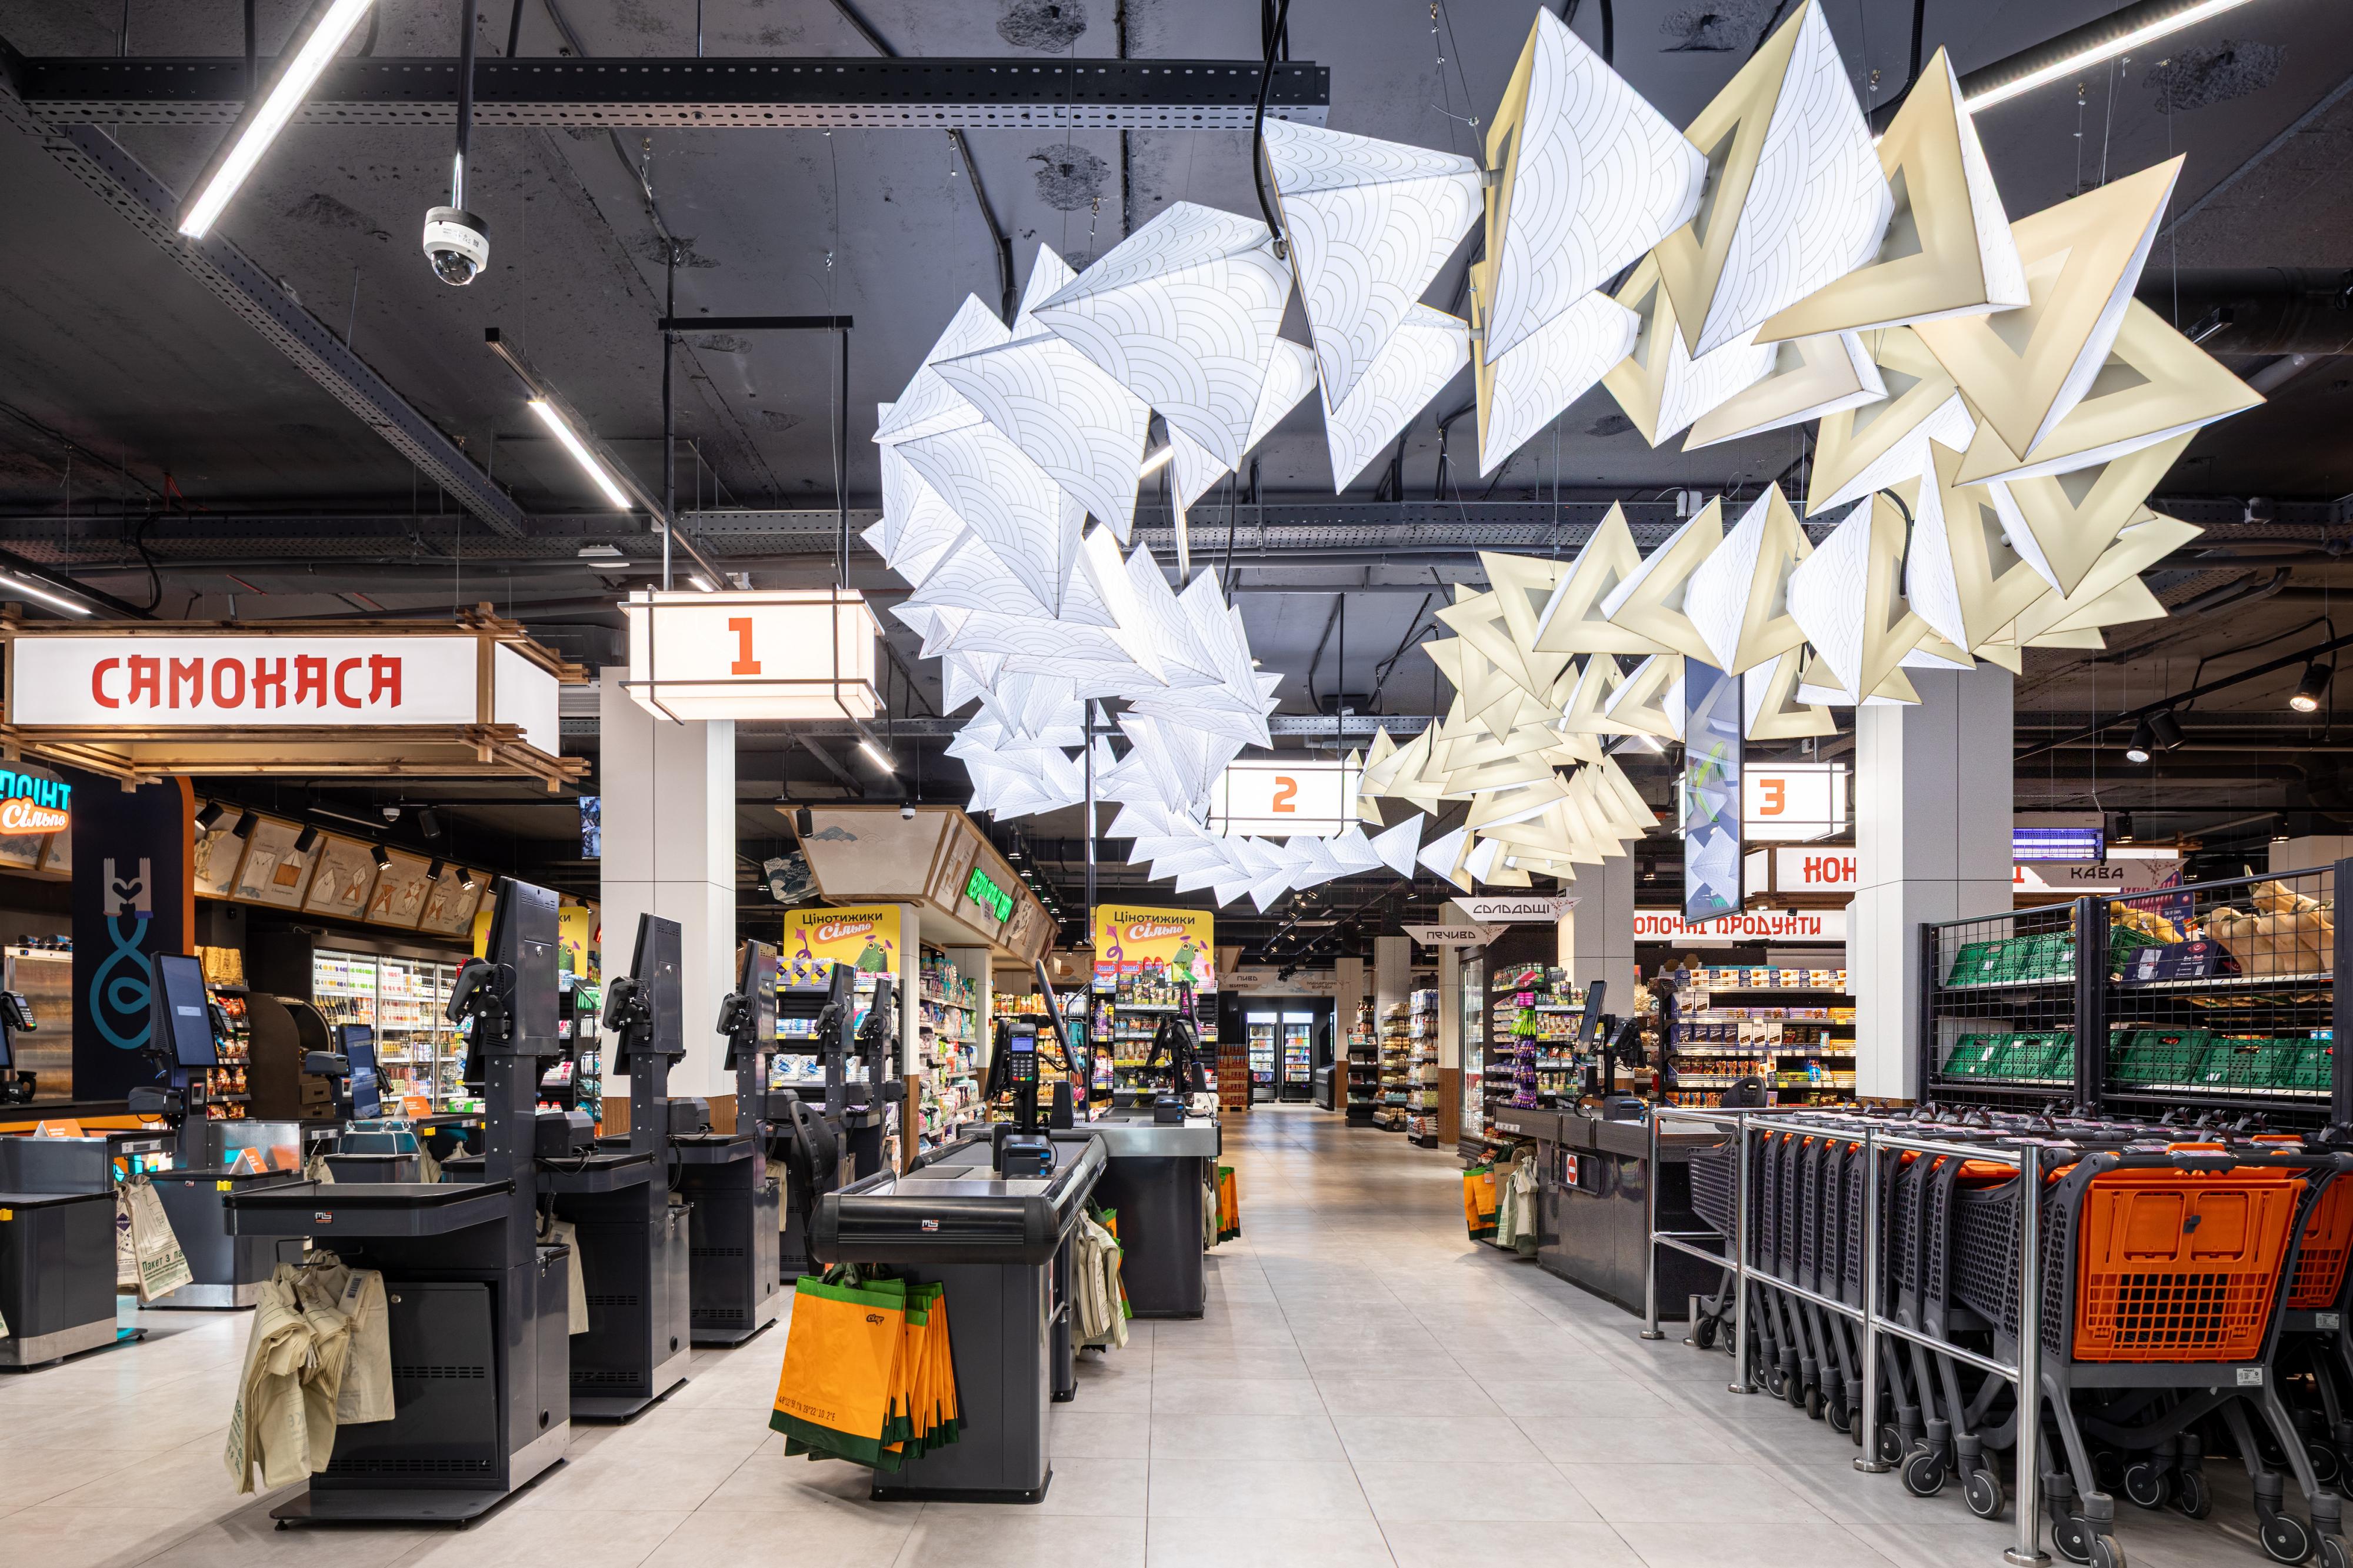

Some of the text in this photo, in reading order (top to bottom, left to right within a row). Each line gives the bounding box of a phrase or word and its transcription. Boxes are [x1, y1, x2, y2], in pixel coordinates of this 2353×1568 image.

[729, 618, 761, 675] 1
[92, 654, 402, 709] САМОКАСА
[1273, 776, 1297, 812] 2
[2, 803, 66, 828] Сільпо
[2071, 868, 2124, 879] КАВА
[1474, 904, 1549, 914] СОЛОДОЩІ
[802, 913, 882, 926] Цінотижики
[1114, 912, 1195, 925] Цінотижики
[1634, 916, 1821, 935] ОЛОЧНІ ПРОДУКТИ
[819, 923, 871, 940] Сільпо
[1129, 922, 1182, 939] Сільпо
[1426, 930, 1476, 939] ПЕЧИВО
[142, 1257, 163, 1273] Пакет
